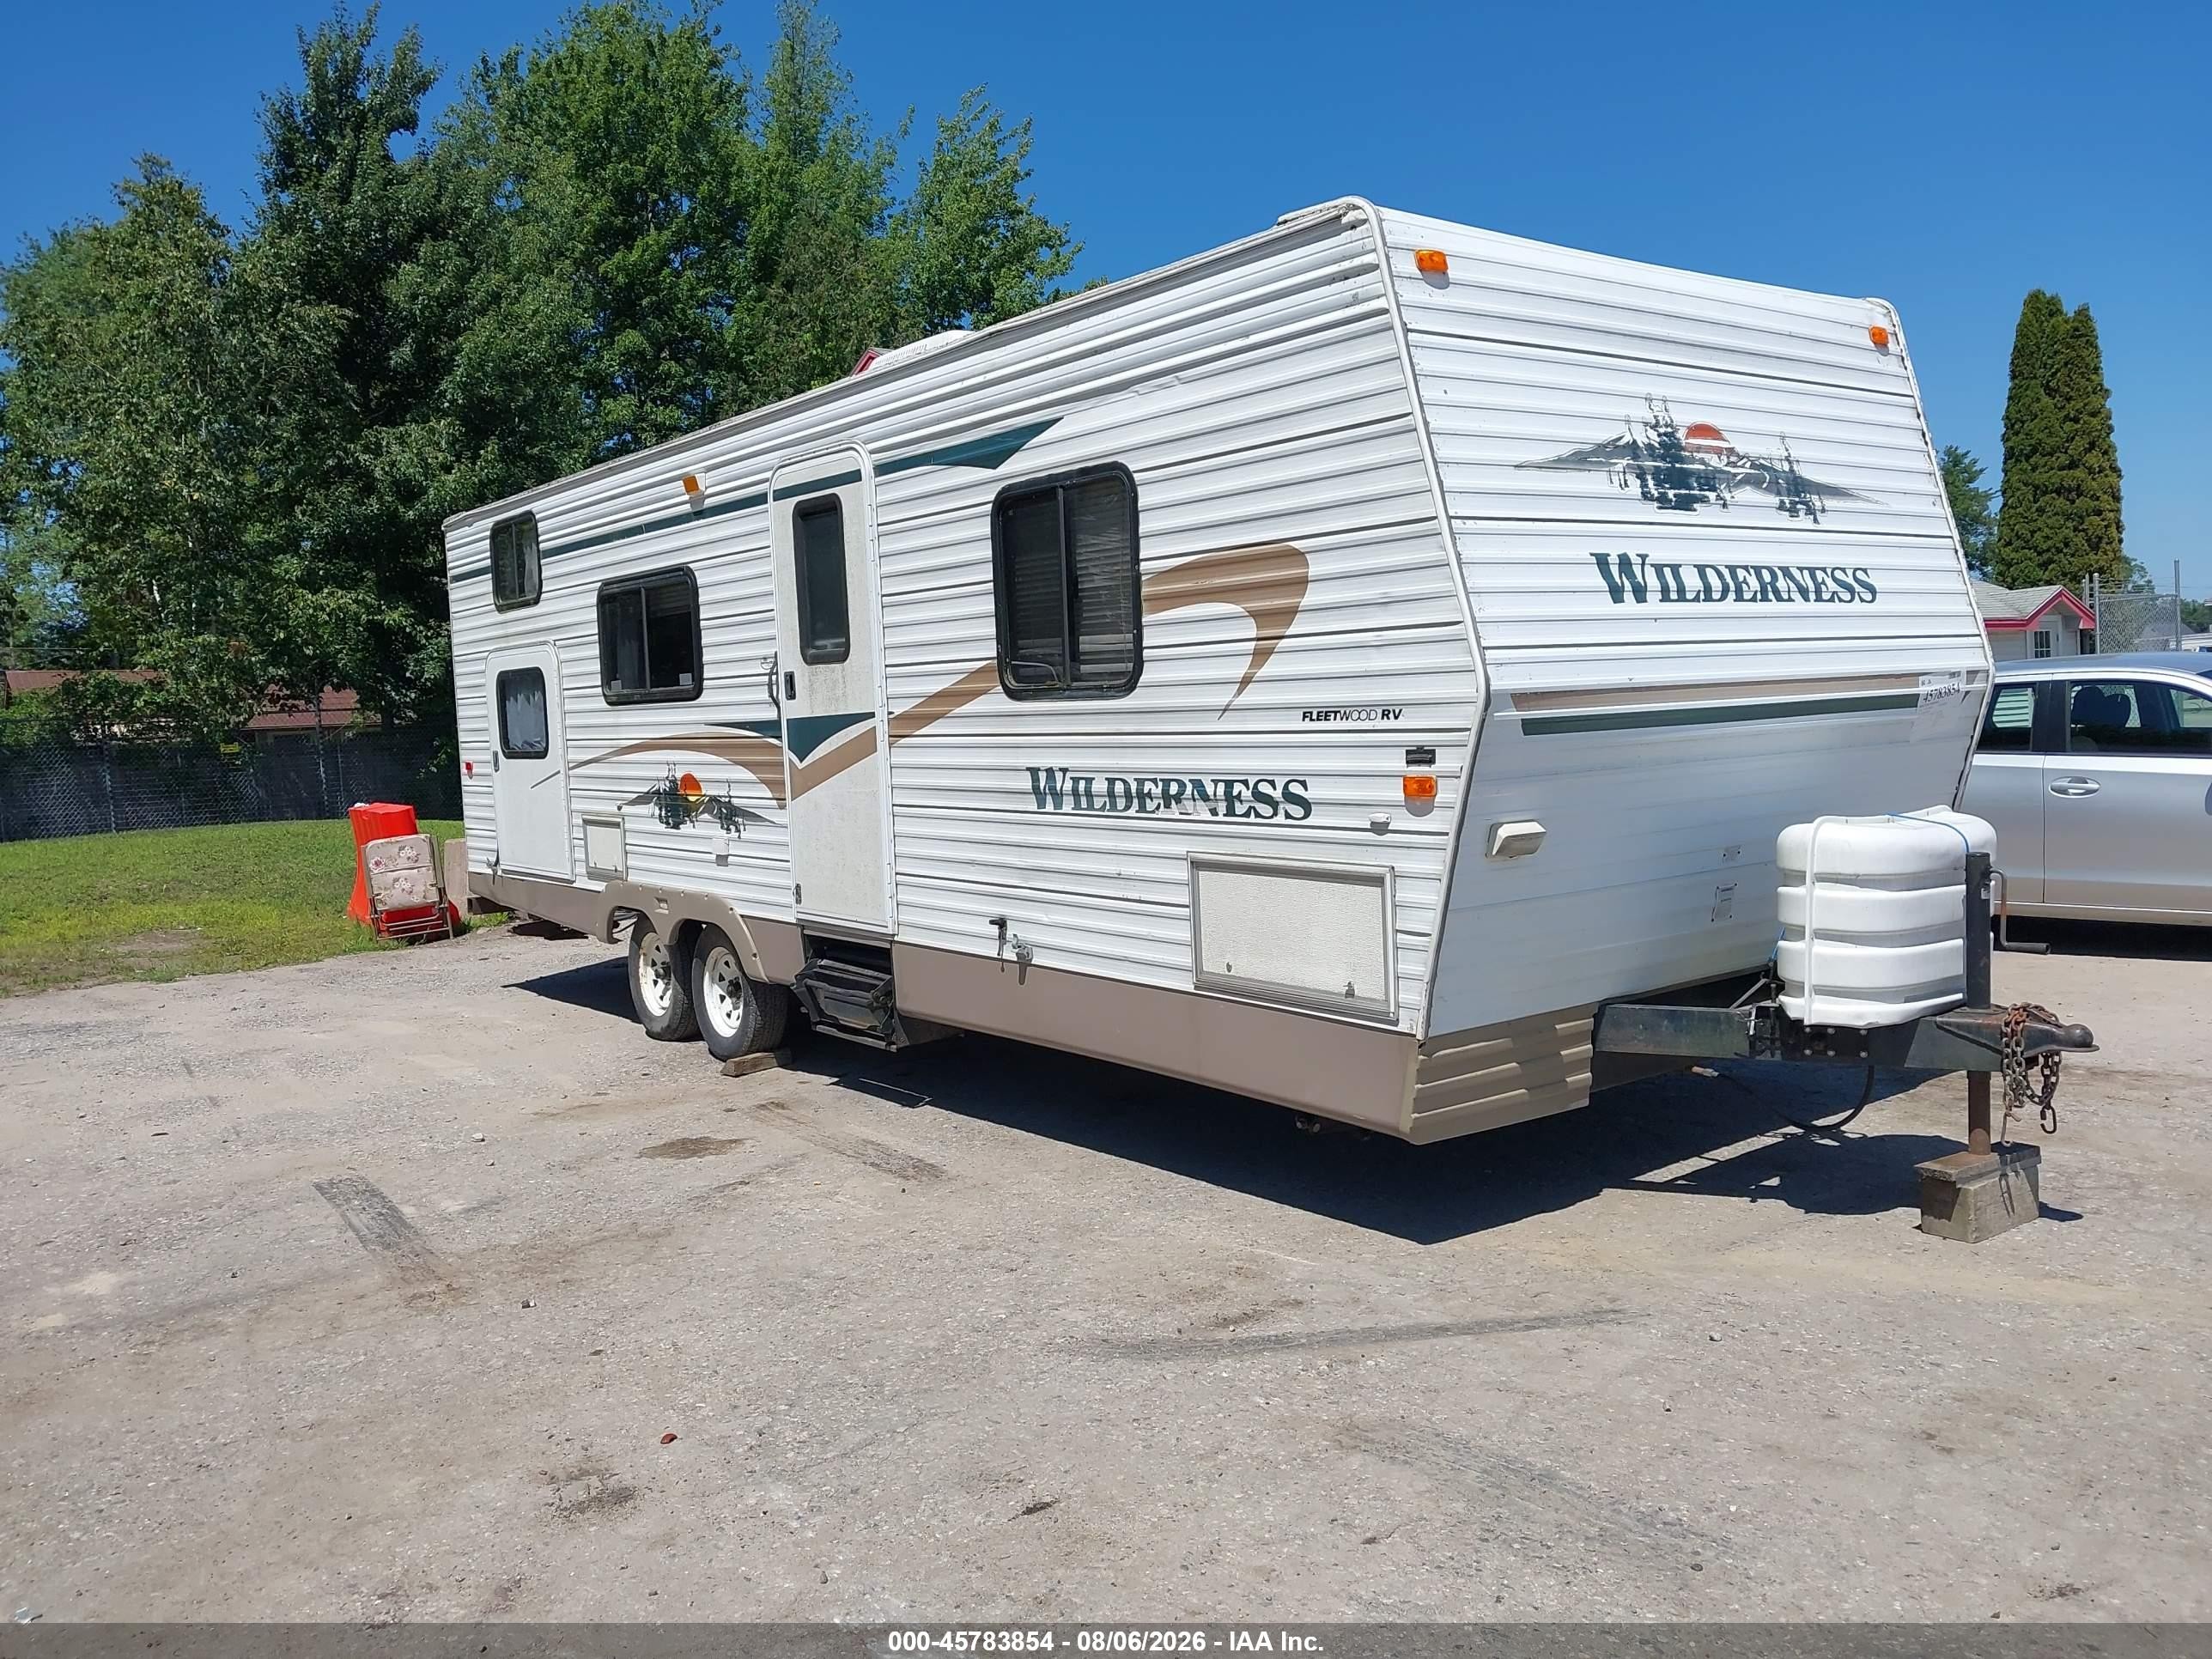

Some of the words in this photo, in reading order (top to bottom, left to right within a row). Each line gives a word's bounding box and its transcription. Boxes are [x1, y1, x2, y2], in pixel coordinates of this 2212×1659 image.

[1589, 551, 1877, 604] WILDERNESS
[1923, 682, 1960, 703] 45783854
[1301, 708, 1378, 722] FLEETWOOD
[1380, 708, 1403, 721] RV
[1025, 766, 1313, 821] WILDERNESS
